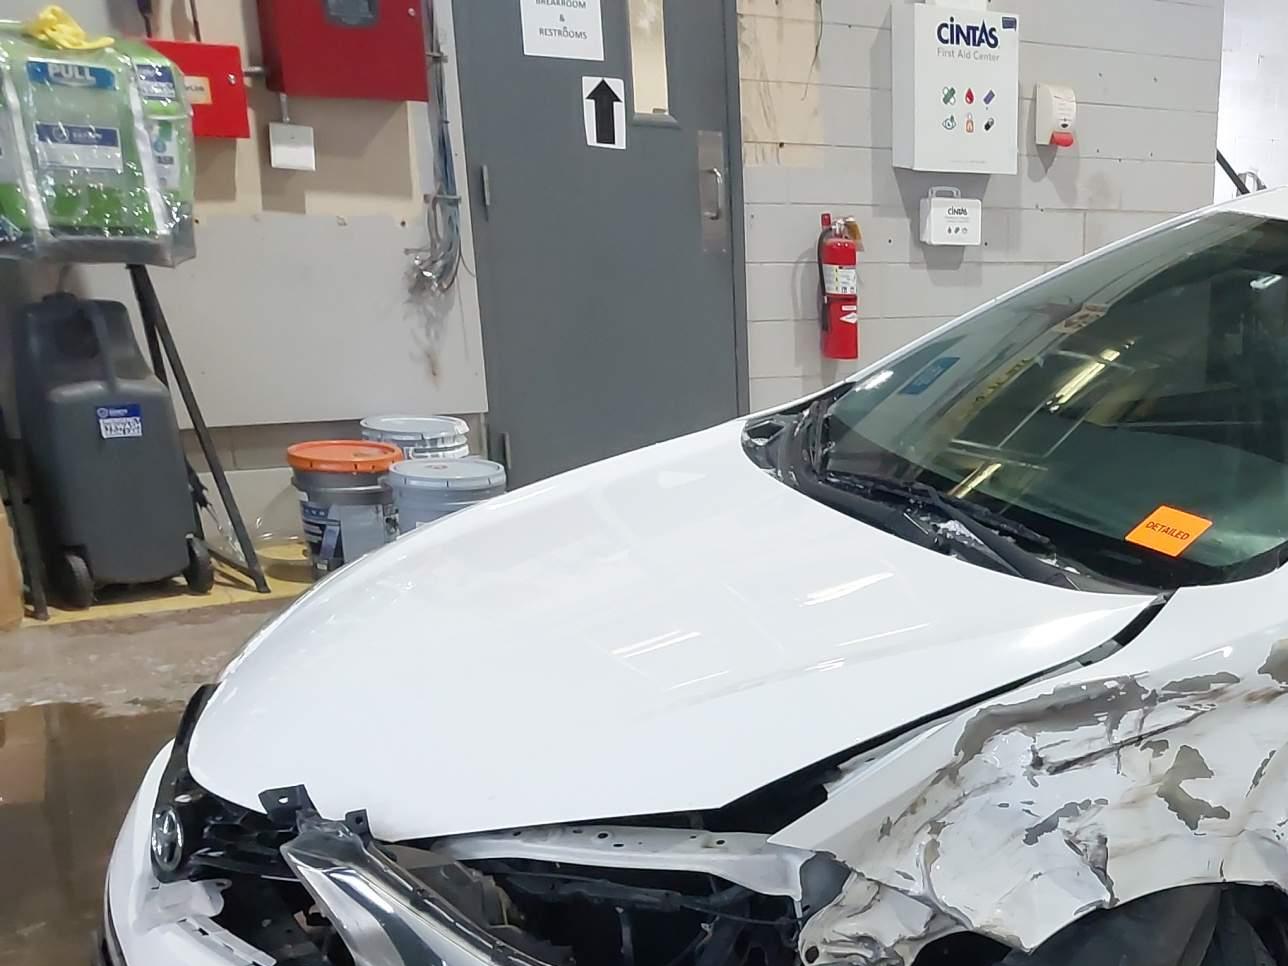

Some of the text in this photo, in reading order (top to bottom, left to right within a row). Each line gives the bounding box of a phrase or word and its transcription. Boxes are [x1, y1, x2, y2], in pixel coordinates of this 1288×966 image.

[539, 28, 588, 39] RESTROOMS
[937, 48, 1000, 61] First Aid Center
[49, 63, 97, 81] PULL
[1145, 521, 1190, 540] DETAILED
